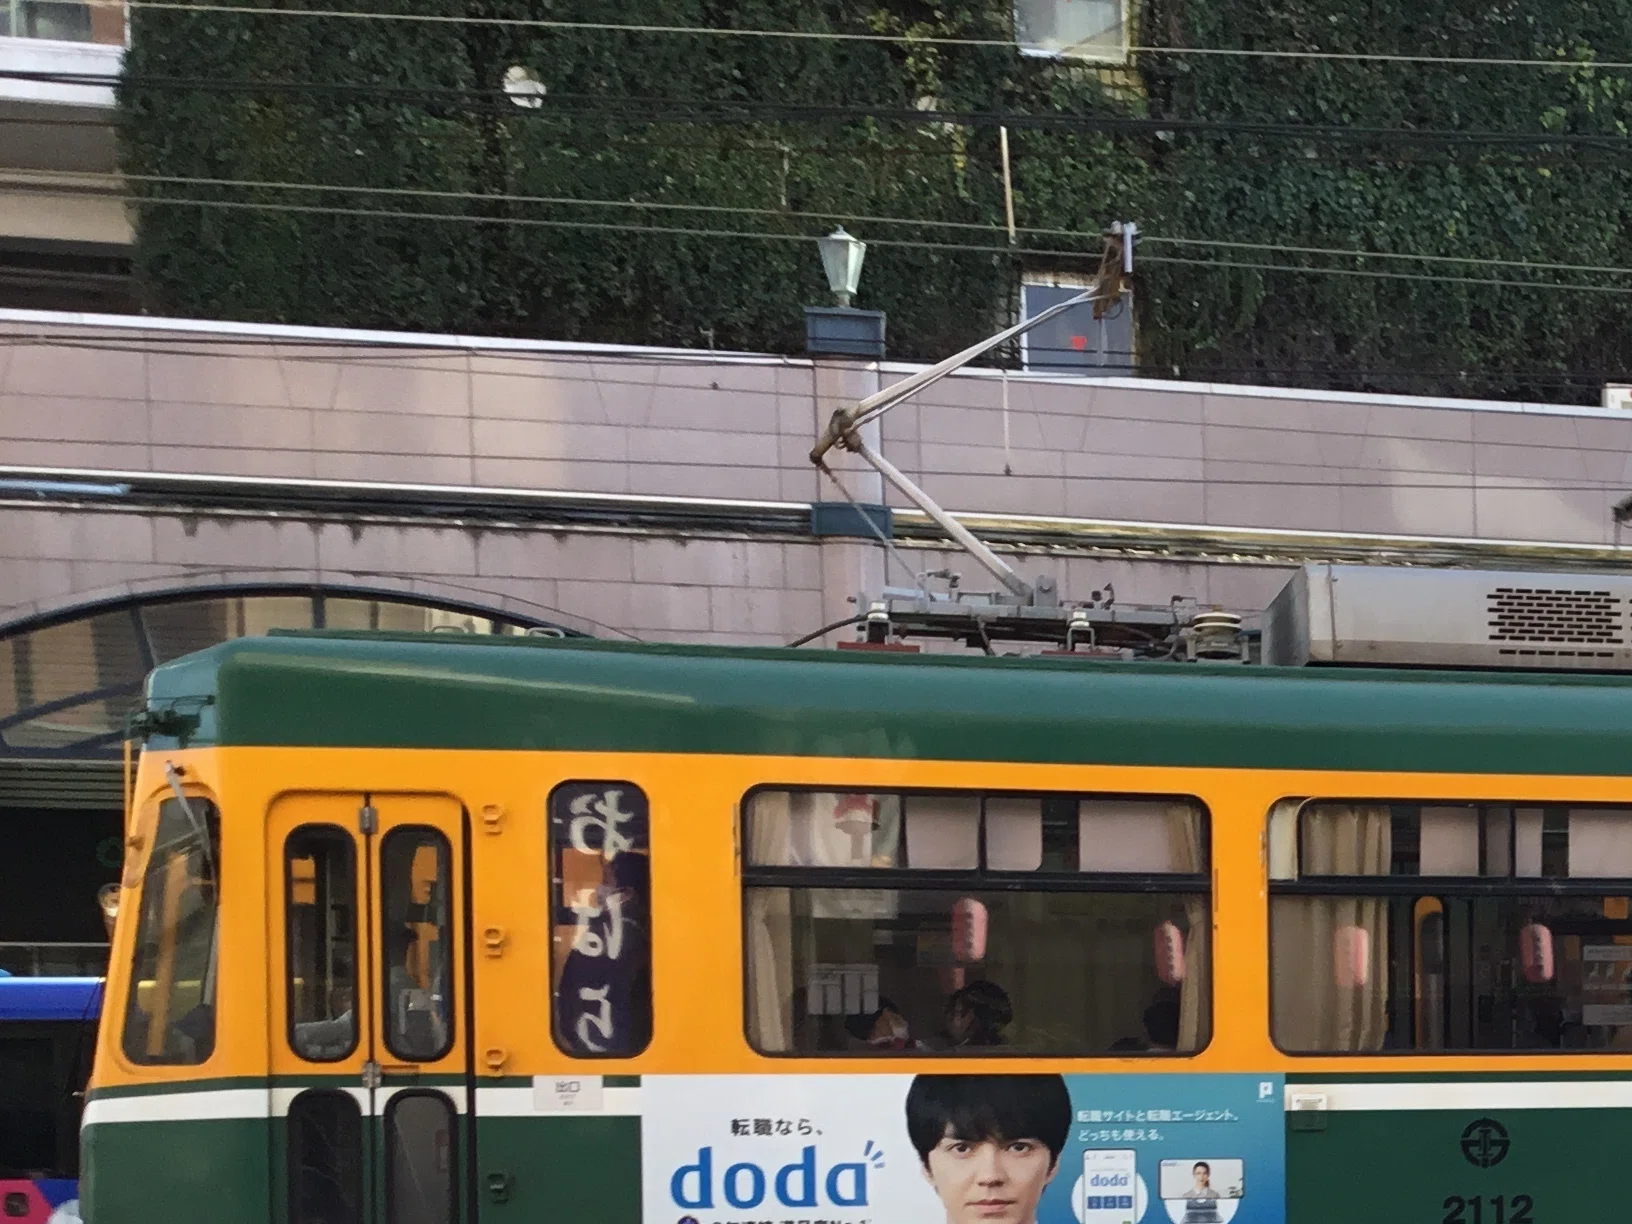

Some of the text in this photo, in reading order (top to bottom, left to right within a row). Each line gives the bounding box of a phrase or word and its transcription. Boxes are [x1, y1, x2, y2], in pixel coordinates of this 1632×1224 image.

[555, 1081, 581, 1093] 出口
[730, 1118, 824, 1136] 転職なら、
[670, 1145, 870, 1209] doda
[1090, 1173, 1129, 1187] doda
